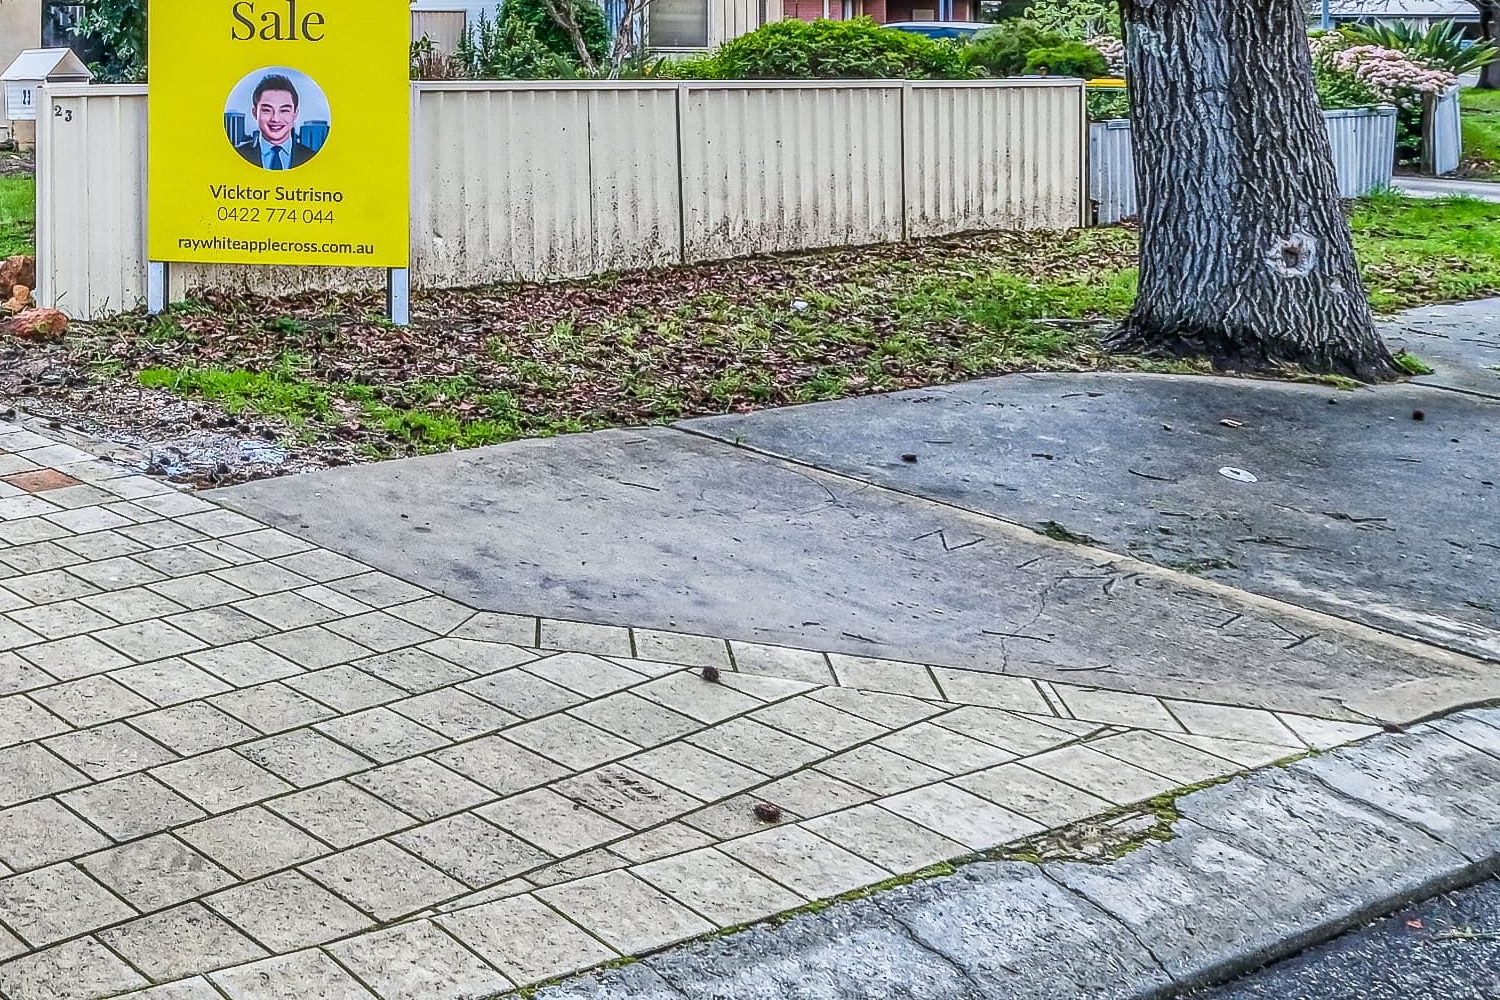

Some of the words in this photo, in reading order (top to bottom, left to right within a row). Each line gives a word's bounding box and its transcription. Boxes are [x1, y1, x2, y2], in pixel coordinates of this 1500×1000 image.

[22, 89, 31, 106] 23
[54, 105, 73, 122] 23
[209, 184, 270, 200] Vicktor
[275, 186, 343, 202] Sutrisno
[217, 206, 260, 222] 0422
[266, 208, 297, 223] 774
[302, 209, 334, 224] 044
[178, 236, 374, 254] raywhiteapplecross.com.au
